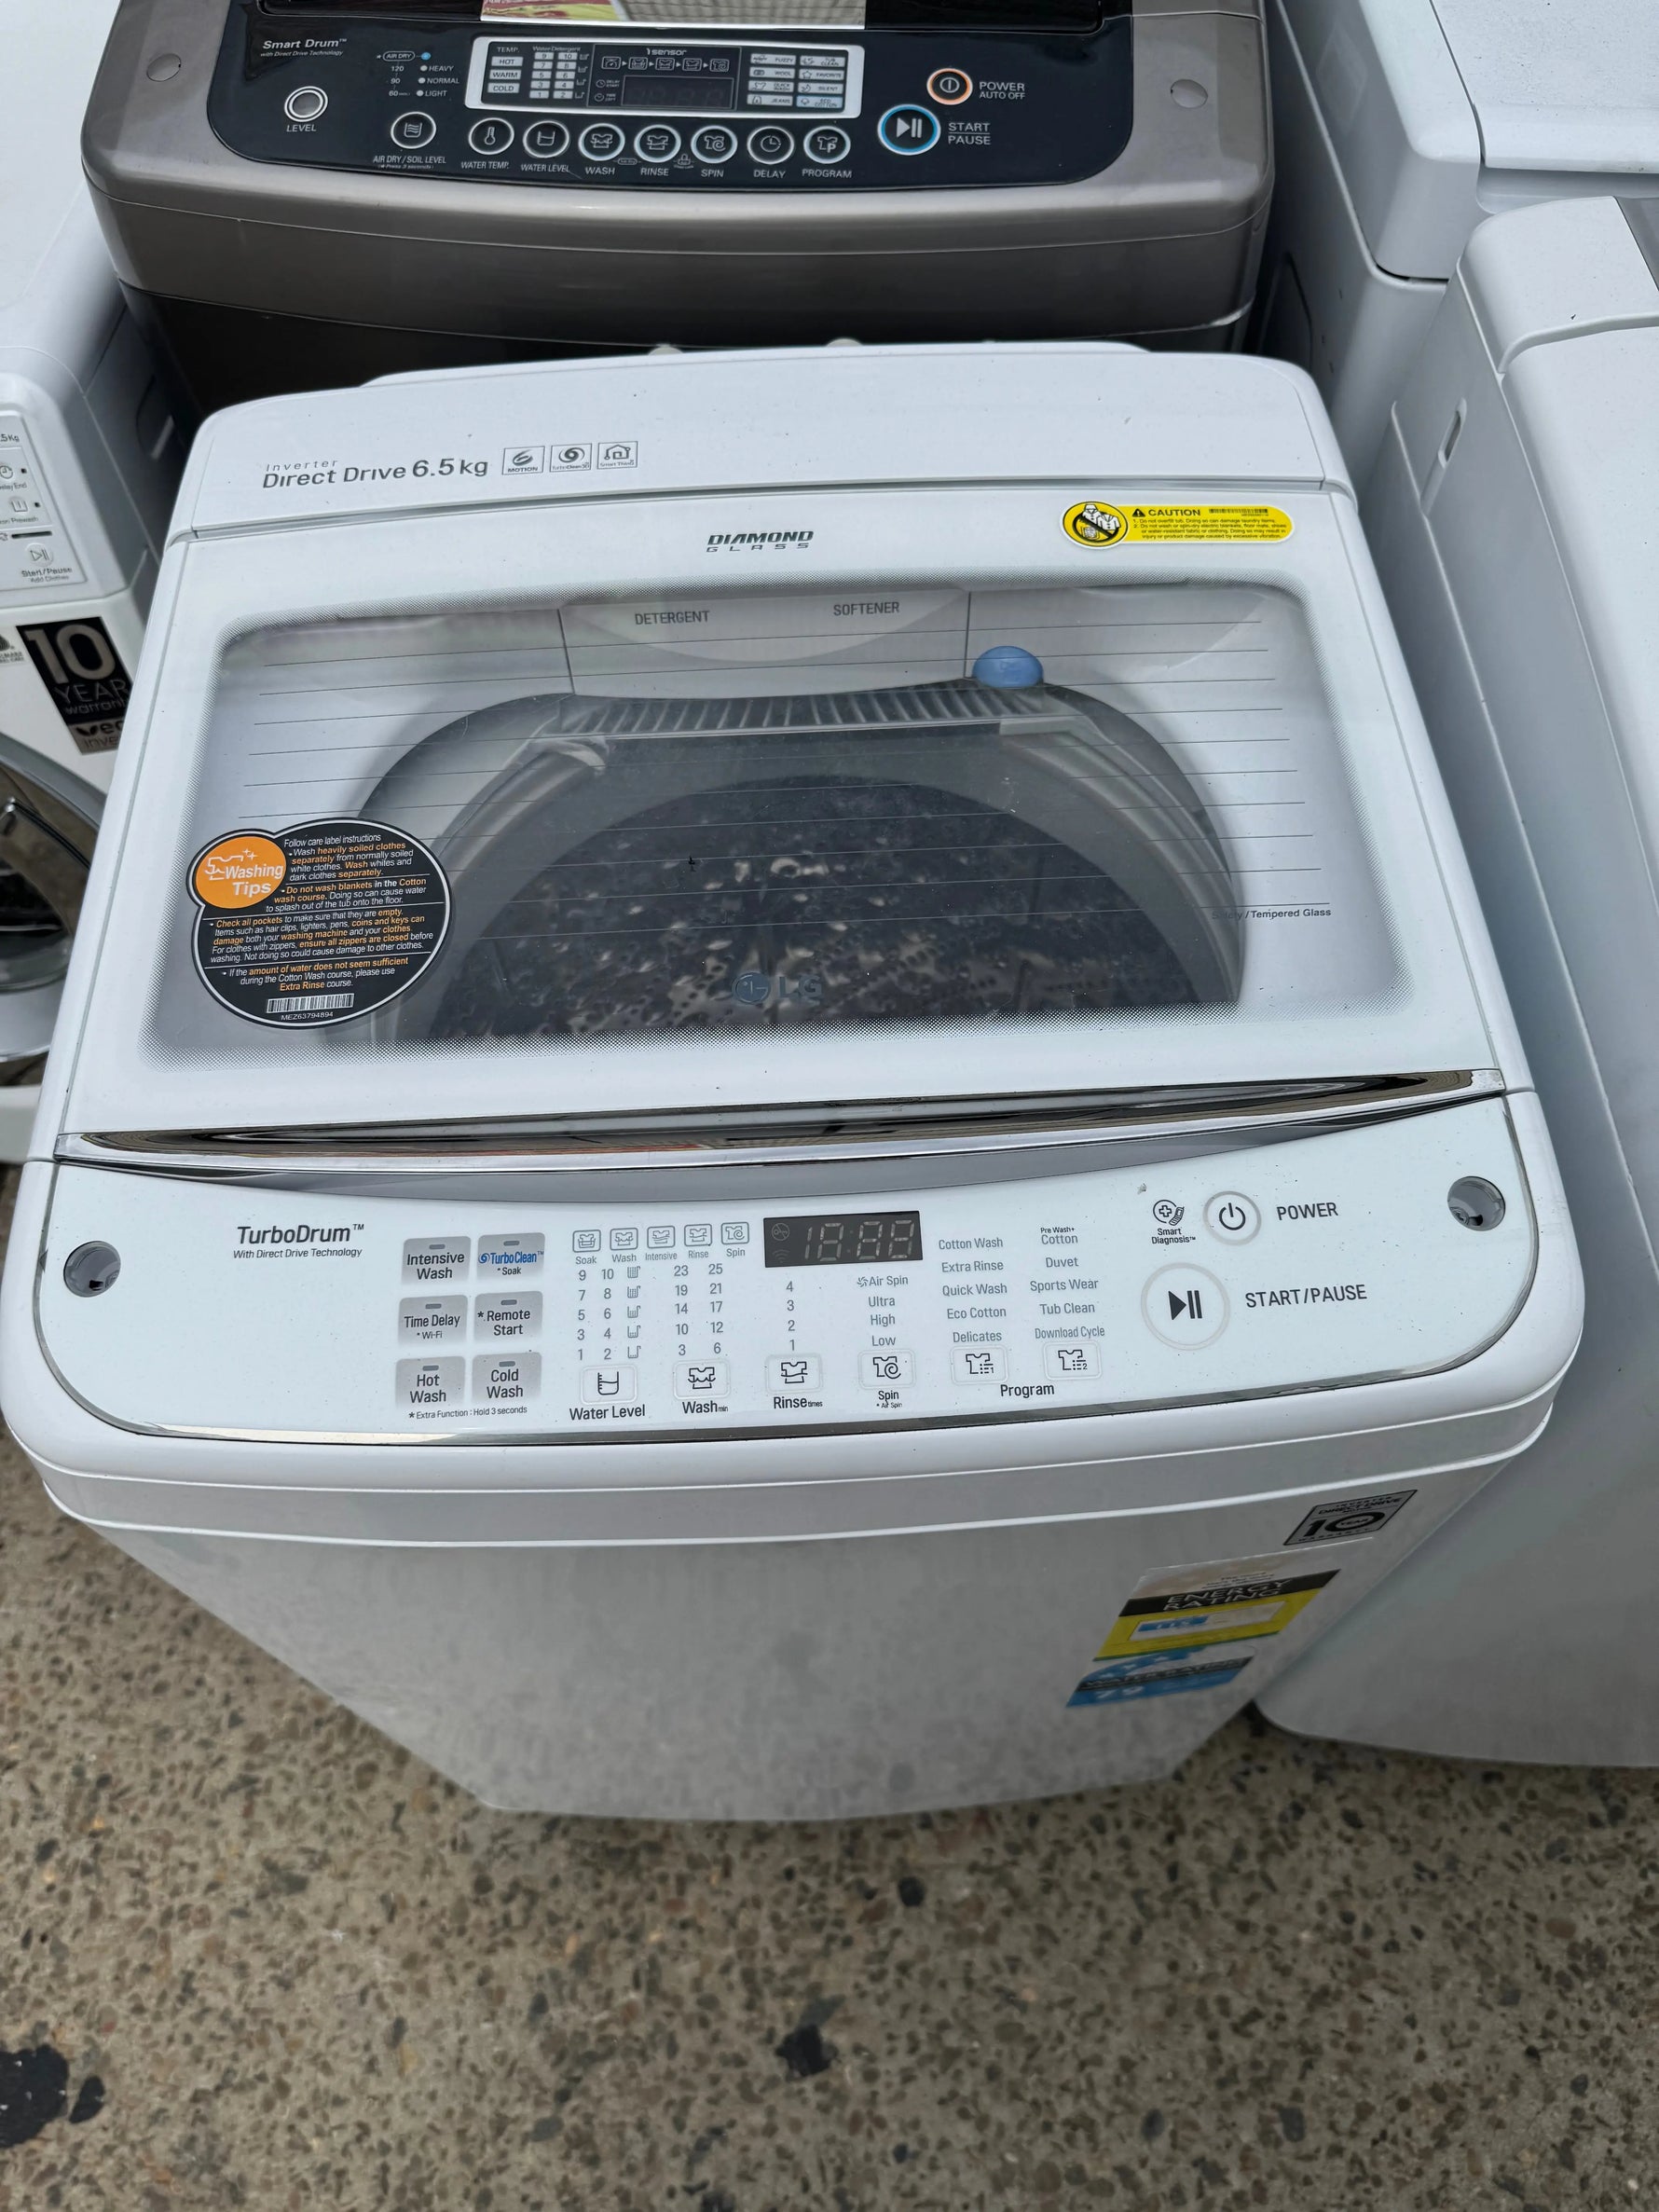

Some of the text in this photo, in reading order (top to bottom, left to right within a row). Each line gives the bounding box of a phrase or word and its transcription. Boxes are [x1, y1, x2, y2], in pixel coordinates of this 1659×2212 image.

[263, 39, 301, 49] Smart
[980, 81, 1025, 91] POWER
[980, 91, 1006, 100] AUTO
[286, 124, 317, 132] LEVEL
[948, 122, 990, 131] START
[948, 136, 992, 145] PAUSE
[548, 164, 570, 172] LEVEL
[802, 170, 852, 178] PROGRAM
[266, 460, 338, 473] Inverter
[263, 469, 336, 489] Direct
[343, 466, 406, 484] Drive
[708, 531, 814, 545] DIAMOND
[706, 543, 809, 552] GLASS
[833, 601, 900, 616] SOFTENER
[634, 611, 710, 625] DETERGENT
[24, 624, 117, 684] 10
[54, 679, 129, 704] YEAR
[284, 834, 381, 847] Follow care label instructions
[225, 863, 284, 880] Washing
[232, 882, 271, 898] Tips
[253, 916, 282, 927] pockets
[348, 911, 363, 919] they
[377, 909, 403, 917] empty.
[1252, 910, 1299, 919] Tempered
[303, 981, 324, 990] Rinse
[326, 980, 353, 988] course.
[779, 974, 822, 998] LG
[1276, 1202, 1338, 1221] POWER
[939, 1238, 1003, 1250] Cotton Wash
[1041, 1234, 1078, 1244] Cotton
[233, 1248, 363, 1259] With Direct Drive Technology
[406, 1252, 465, 1265] Intensive
[611, 1253, 637, 1263] Wash
[645, 1252, 678, 1261] Intensive
[688, 1250, 709, 1258] Rinse
[726, 1248, 746, 1257] Spin
[575, 1256, 596, 1265] Soak
[941, 1260, 1004, 1272] Extra Rinse
[1045, 1257, 1079, 1268] Duvet
[417, 1267, 453, 1280] Wash
[501, 1266, 522, 1275] Soak
[578, 1268, 614, 1281] 9 10
[674, 1263, 723, 1277] 23 25
[869, 1276, 909, 1287] Air Spin
[1030, 1279, 1099, 1293] Sports Wear
[675, 1283, 722, 1296] 19 21
[942, 1284, 1008, 1297] Quick Wash
[869, 1297, 895, 1307] Ultra
[1244, 1285, 1367, 1309] START/PAUSE
[675, 1300, 723, 1314] 14 17
[947, 1307, 1007, 1319] Eco Cotton
[1039, 1303, 1095, 1314] Tub Clean
[404, 1314, 460, 1327] Time Delay
[487, 1310, 530, 1322] Remote
[871, 1314, 896, 1326] High
[493, 1324, 524, 1336] Start
[675, 1321, 723, 1335] 10 12
[1035, 1326, 1105, 1339] Download Cycle
[422, 1330, 443, 1340] Wi-Fi
[871, 1336, 896, 1346] Low
[953, 1331, 1002, 1343] Delicates
[417, 1374, 440, 1387] Hot
[490, 1369, 519, 1382] Cold
[409, 1390, 446, 1404] Wash
[487, 1385, 524, 1399] Wash
[878, 1390, 899, 1401] Spin
[1000, 1384, 1054, 1398] Program
[682, 1401, 718, 1414] Wash
[774, 1396, 807, 1409] Rinse
[416, 1410, 435, 1419] Extra
[437, 1409, 469, 1418] Function
[473, 1408, 490, 1417] Hold
[497, 1407, 528, 1415] seconds
[569, 1404, 645, 1421] Water Level
[1303, 1512, 1385, 1537] 10
[1167, 1580, 1292, 1603] ENERGY
[1162, 1590, 1280, 1611] RATING
